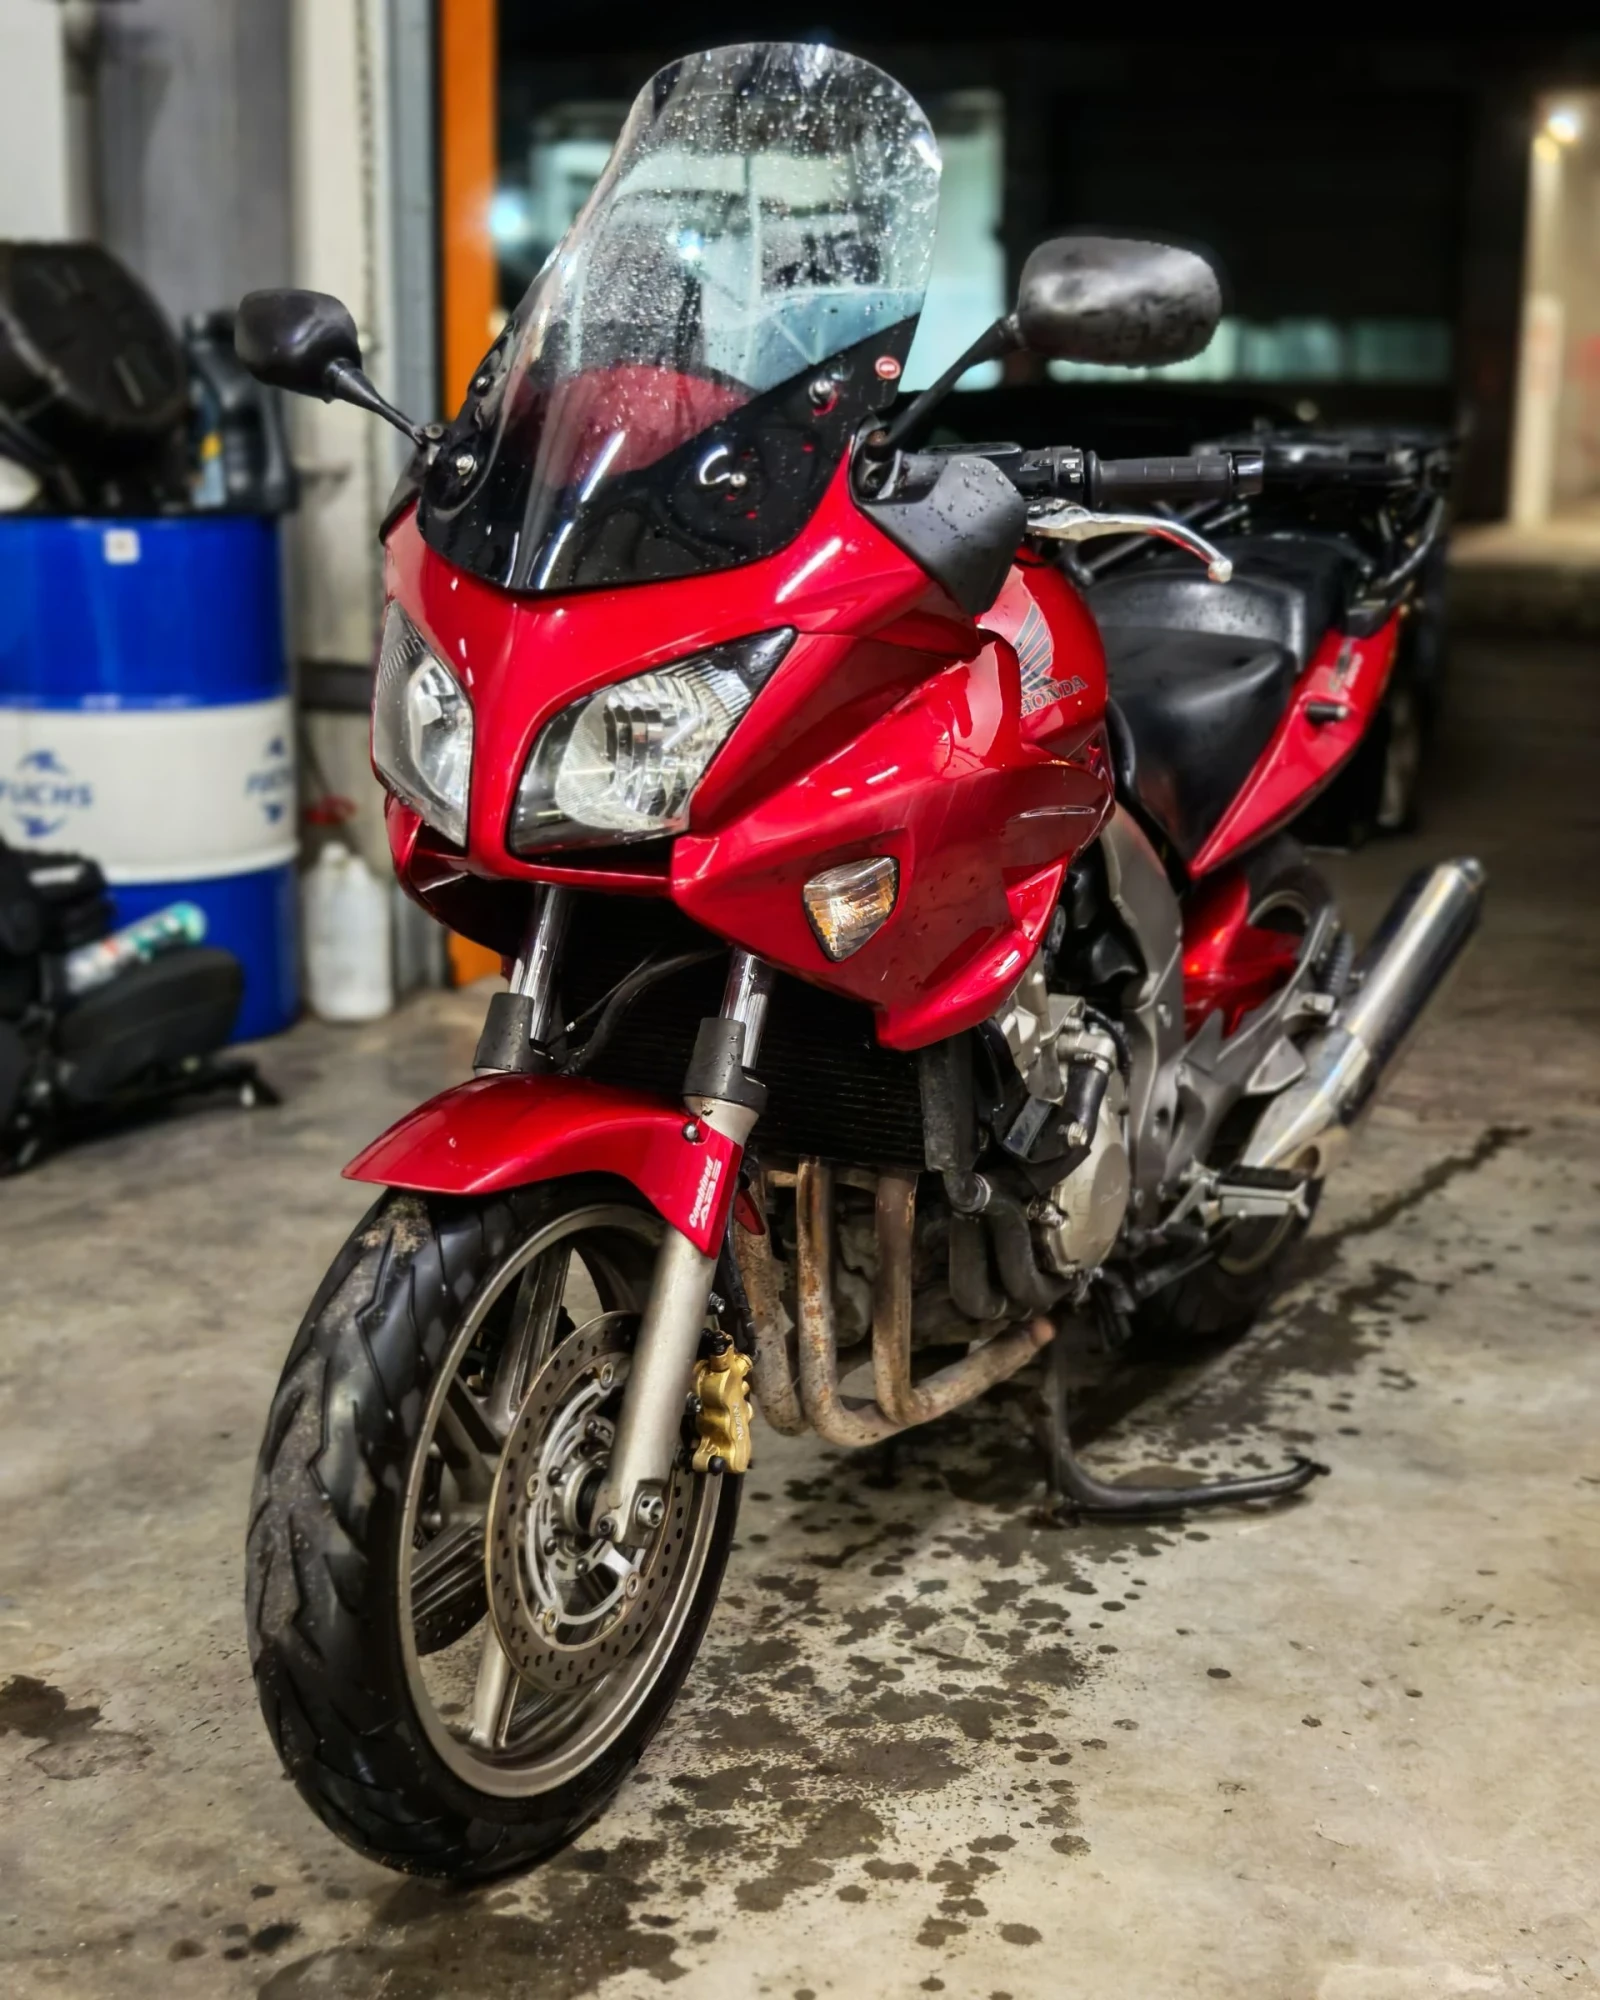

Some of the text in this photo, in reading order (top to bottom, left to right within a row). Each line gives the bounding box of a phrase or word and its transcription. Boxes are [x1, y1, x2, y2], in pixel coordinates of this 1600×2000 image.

[1020, 675, 1088, 718] HONDA
[689, 1155, 714, 1228] Combined
[701, 1158, 722, 1230] ABS
